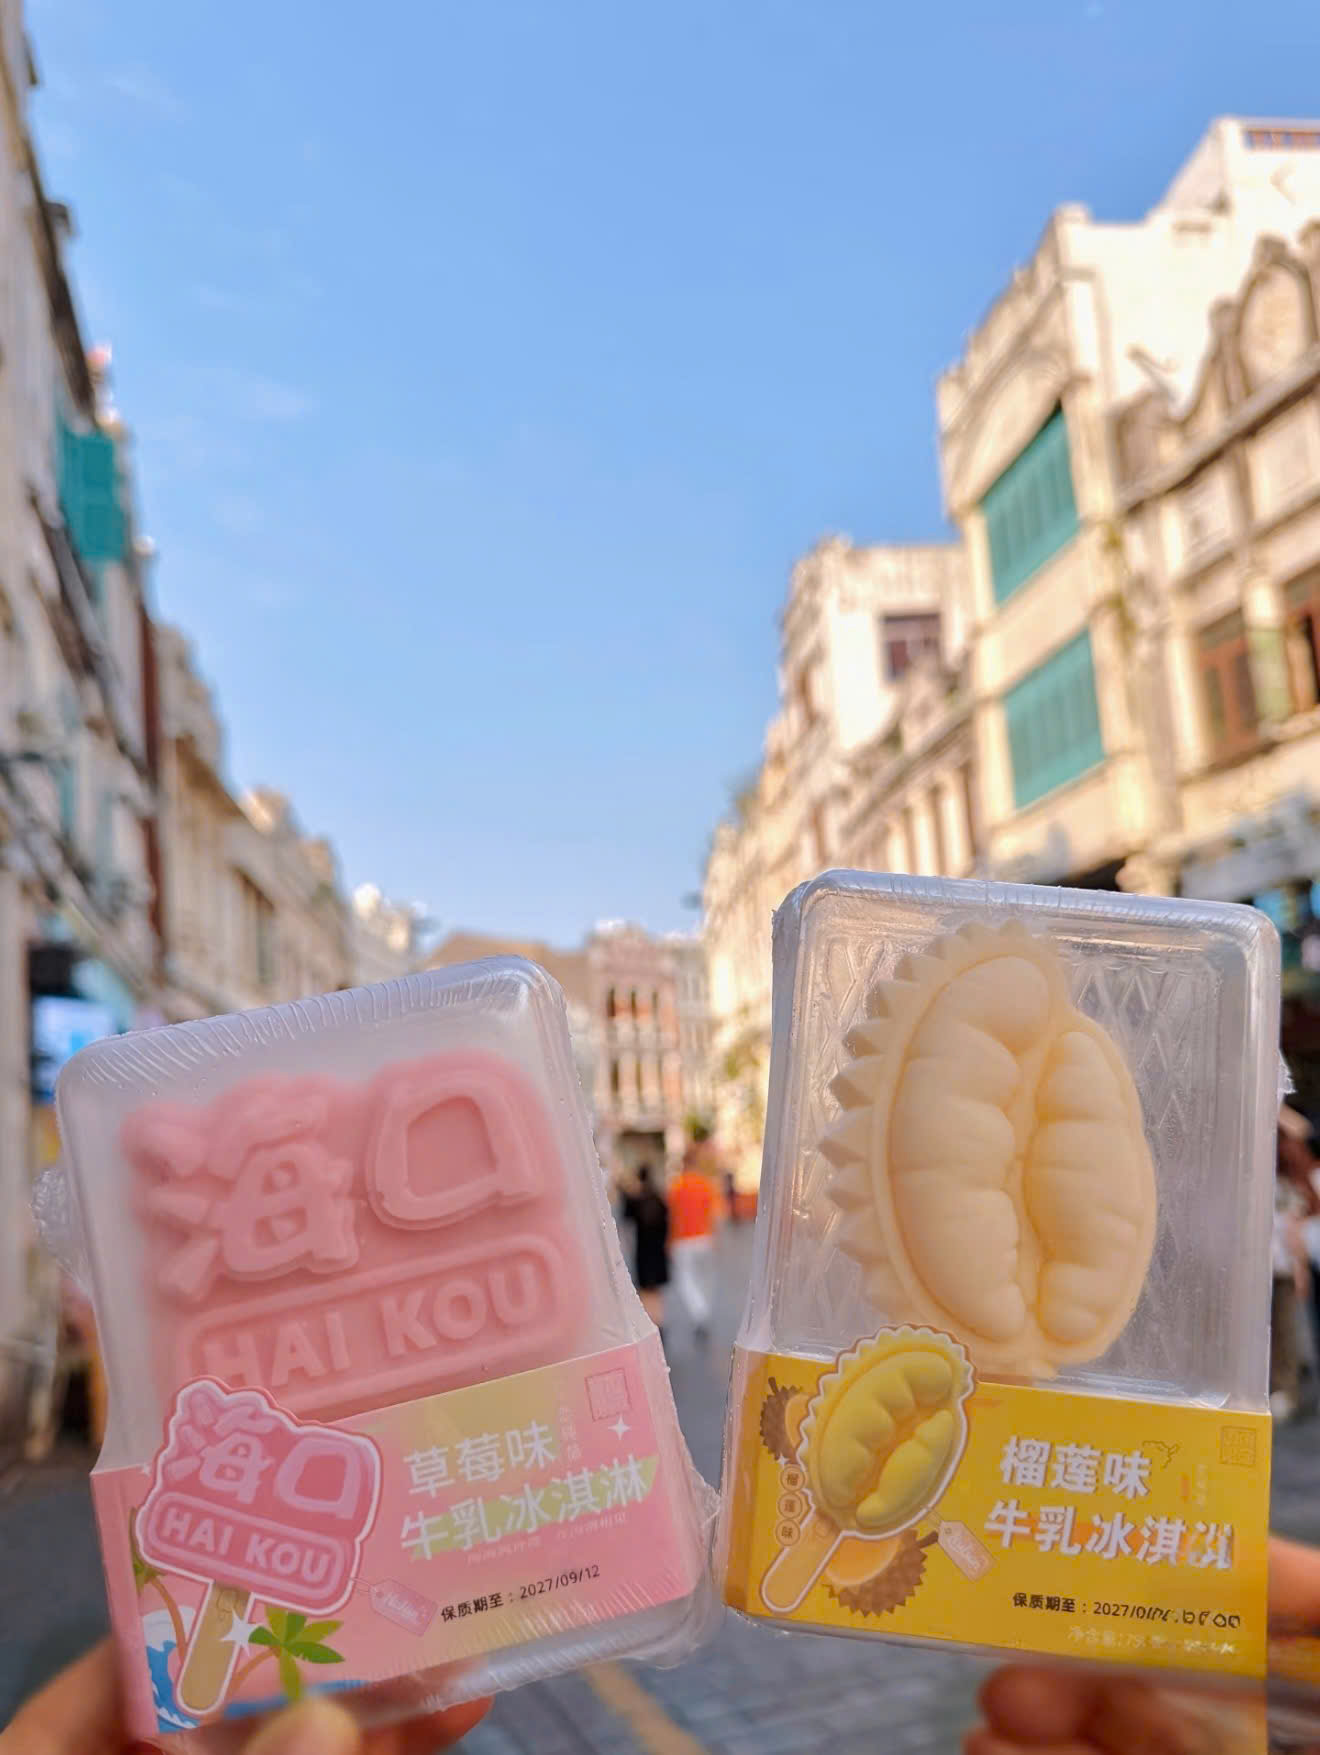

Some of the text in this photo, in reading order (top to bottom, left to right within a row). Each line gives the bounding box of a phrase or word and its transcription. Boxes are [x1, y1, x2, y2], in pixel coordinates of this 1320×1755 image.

[204, 1268, 535, 1389] HAI KOU
[165, 1391, 360, 1520] 海口
[403, 1420, 557, 1499] 草莓味
[1001, 1435, 1152, 1499] 榴莲味
[163, 1508, 330, 1583] HAI KOU
[401, 1454, 648, 1560] 牛乳冰淇淋
